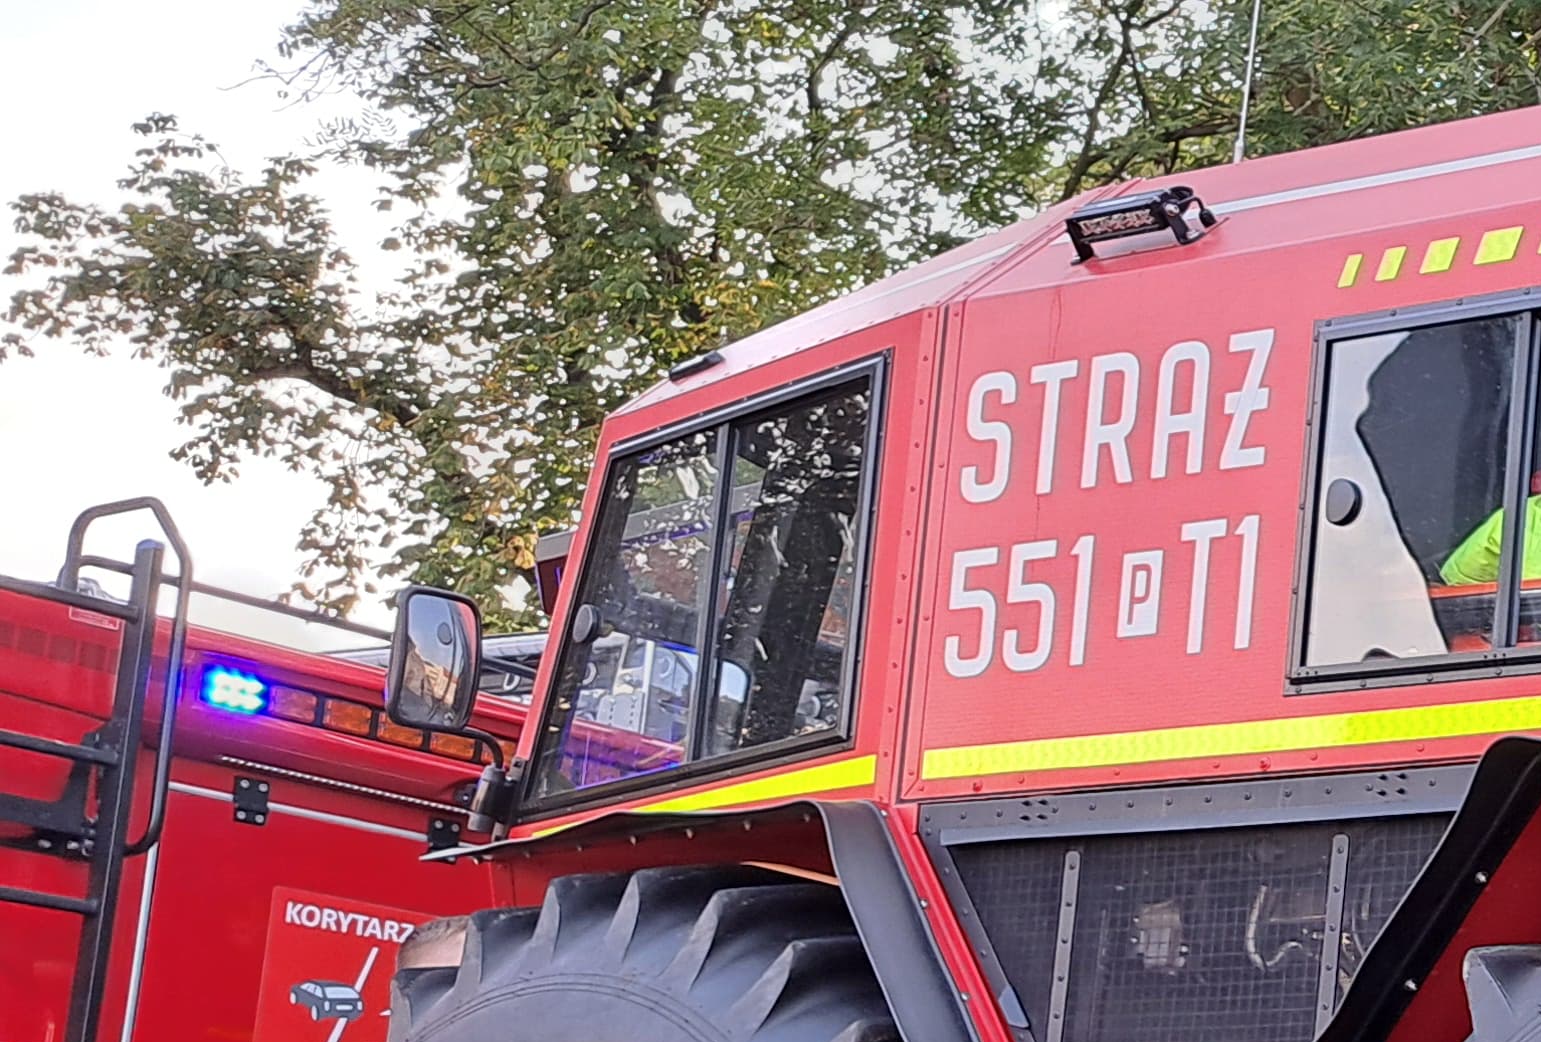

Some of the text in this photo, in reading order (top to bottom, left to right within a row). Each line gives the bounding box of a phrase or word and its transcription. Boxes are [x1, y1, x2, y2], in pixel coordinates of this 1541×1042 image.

[943, 534, 1095, 678] 551
[1180, 513, 1263, 656] T1
[284, 900, 416, 945] KORYTARZ
